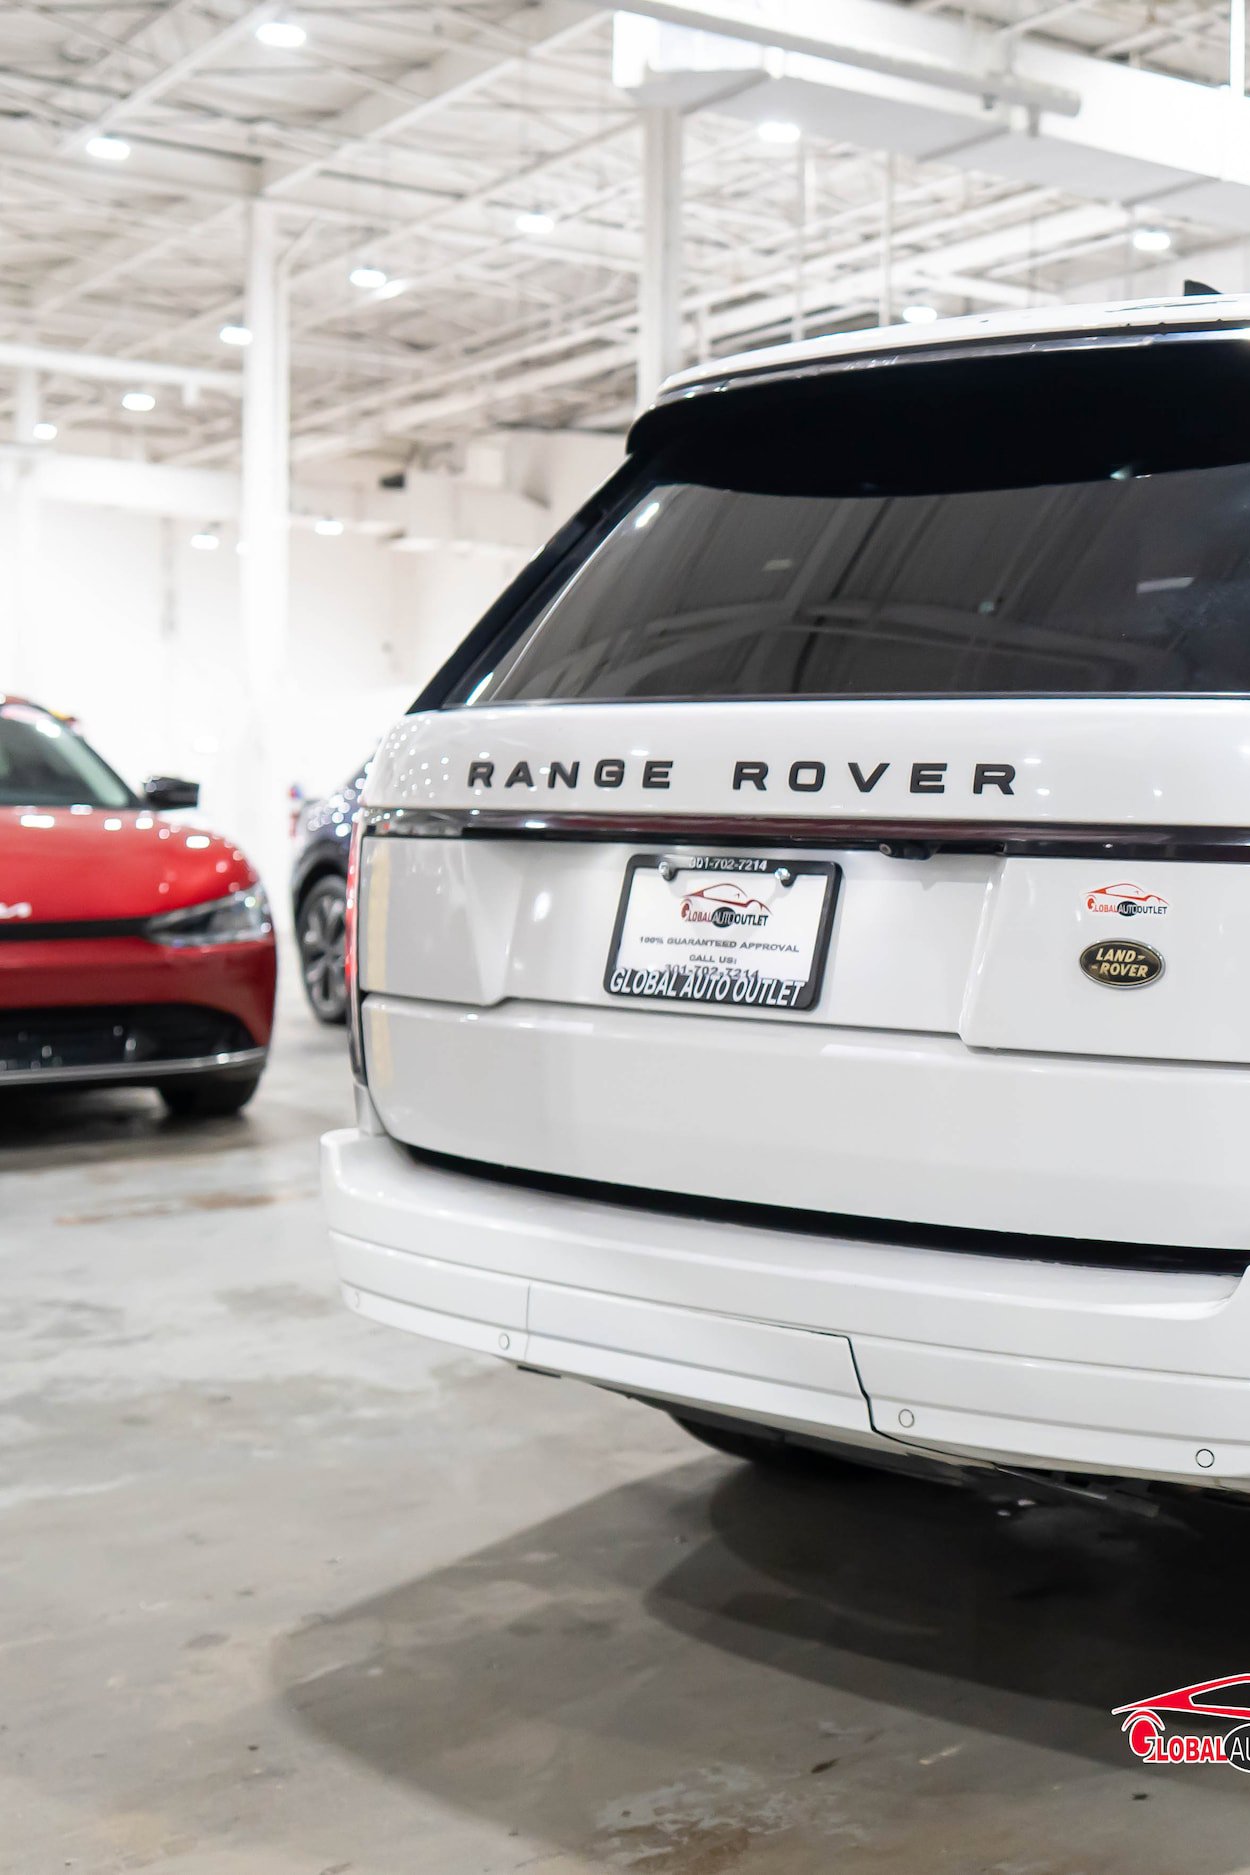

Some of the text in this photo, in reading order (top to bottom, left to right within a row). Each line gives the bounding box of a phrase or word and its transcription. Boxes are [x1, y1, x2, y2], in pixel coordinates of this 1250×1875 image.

[467, 759, 1016, 795] RANGE ROVER
[688, 856, 767, 871] 301-702-7214
[640, 936, 800, 953] 100% GUARANTEED APPROVAL
[689, 954, 737, 965] CALL US:
[1096, 948, 1136, 963] LAND
[1100, 963, 1149, 977] ROVER
[610, 968, 805, 1007] GLOBAL AUTO OUTLET
